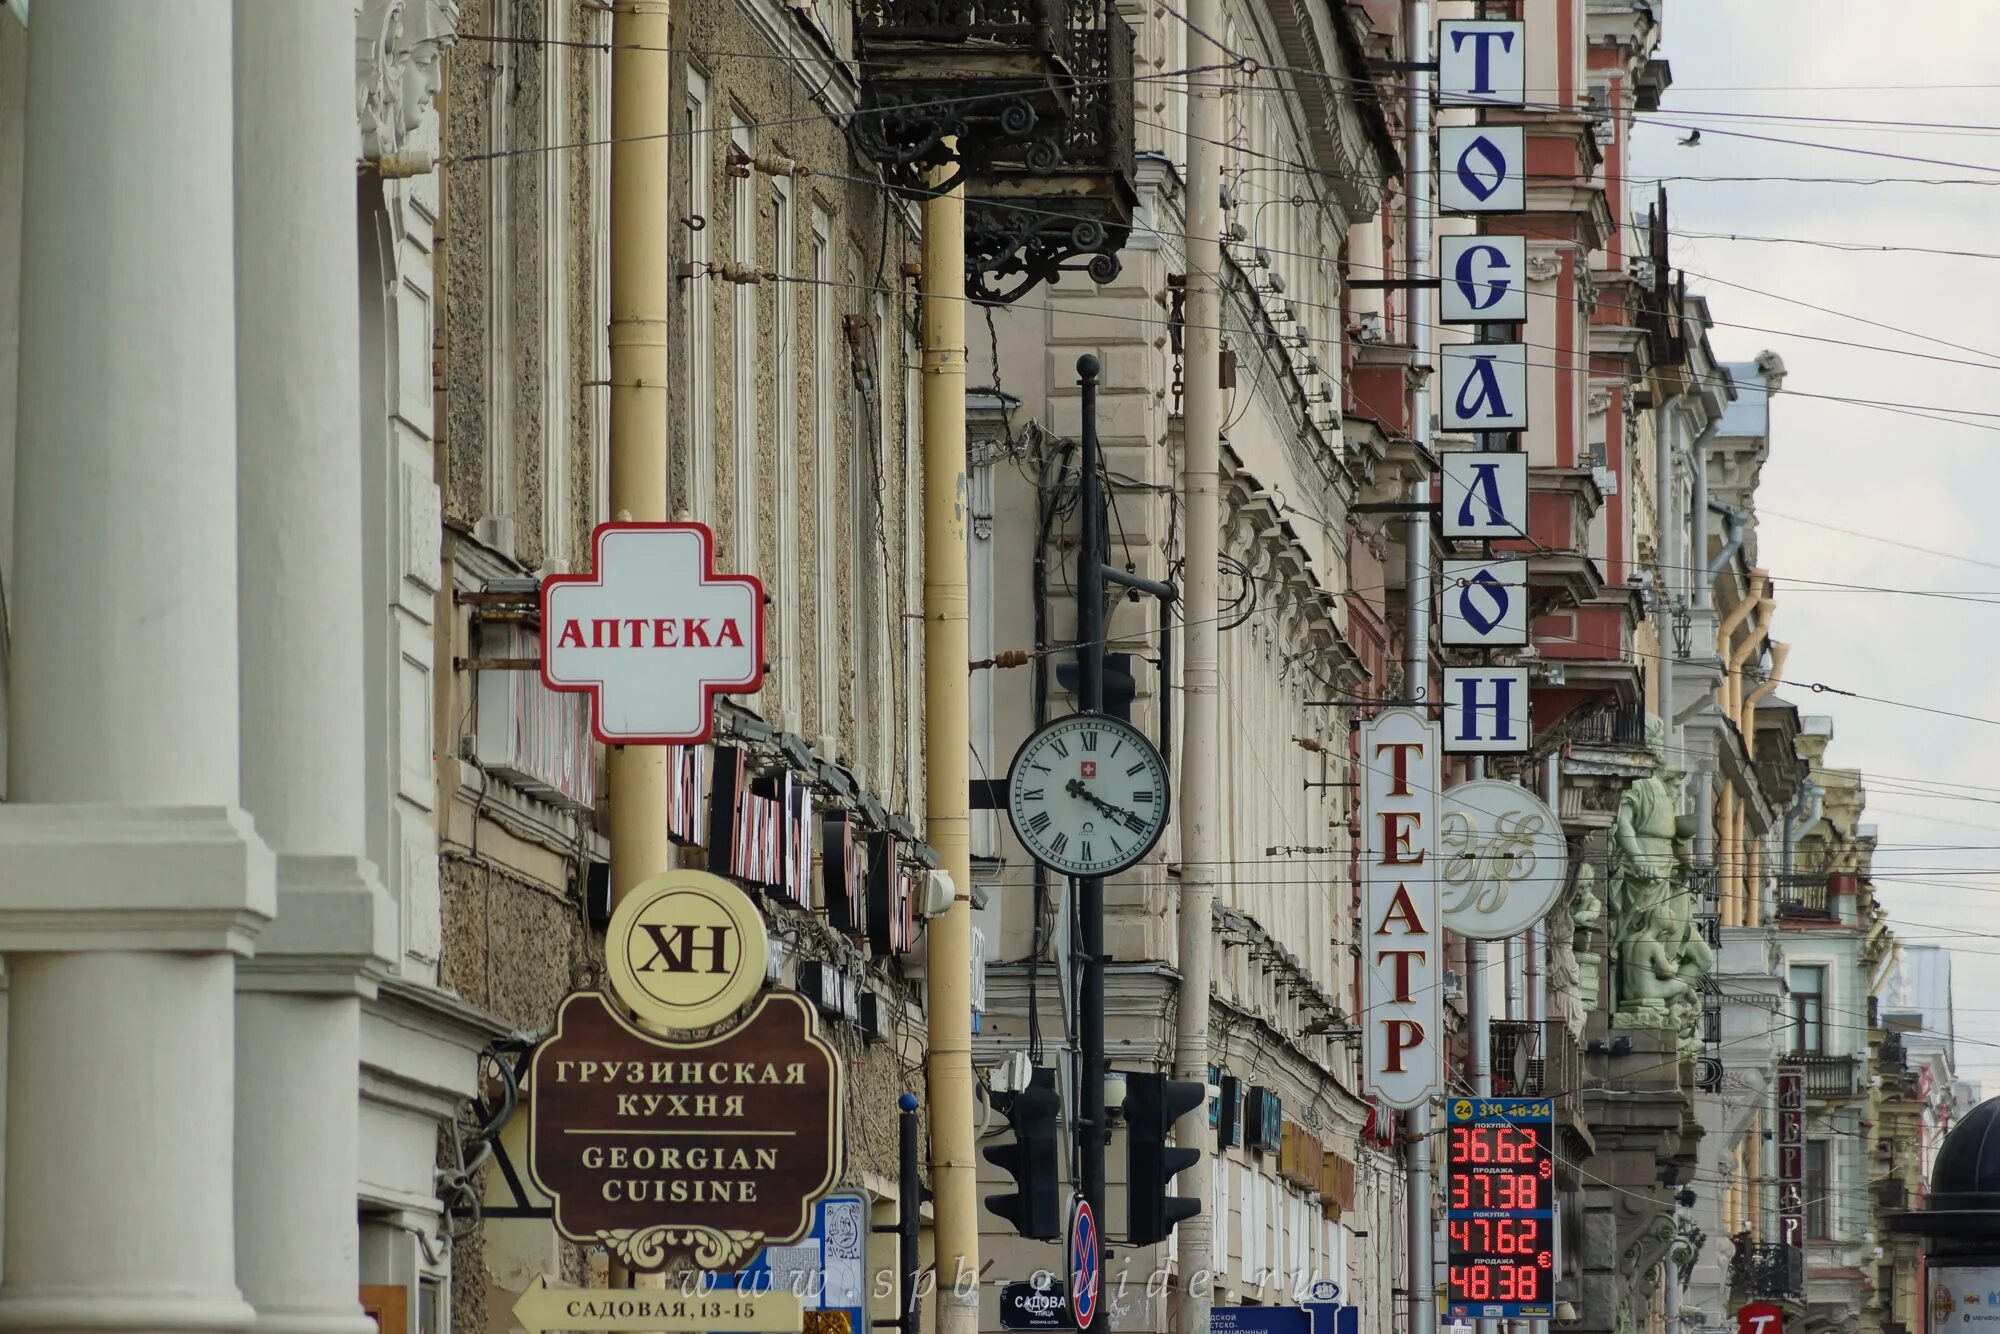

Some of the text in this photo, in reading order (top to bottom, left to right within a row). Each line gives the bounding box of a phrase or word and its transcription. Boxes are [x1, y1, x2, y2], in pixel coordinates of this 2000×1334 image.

[556, 618, 745, 649] АПТЕКА
[1375, 742, 1428, 1074] ТЕАТР
[555, 1061, 806, 1084] ГРУЗИНСКАЯ
[617, 1094, 745, 1117] КУХНЯ
[1456, 1105, 1472, 1115] 24
[1452, 1128, 1536, 1163] 36.62
[582, 1147, 779, 1171] GEORGIAN
[1539, 1158, 1552, 1179] $
[602, 1179, 758, 1203] CUISINE
[1452, 1174, 1537, 1209] 37.38
[1450, 1219, 1537, 1254] 47.62
[1537, 1251, 1552, 1268] €
[1450, 1265, 1537, 1300] 48.38
